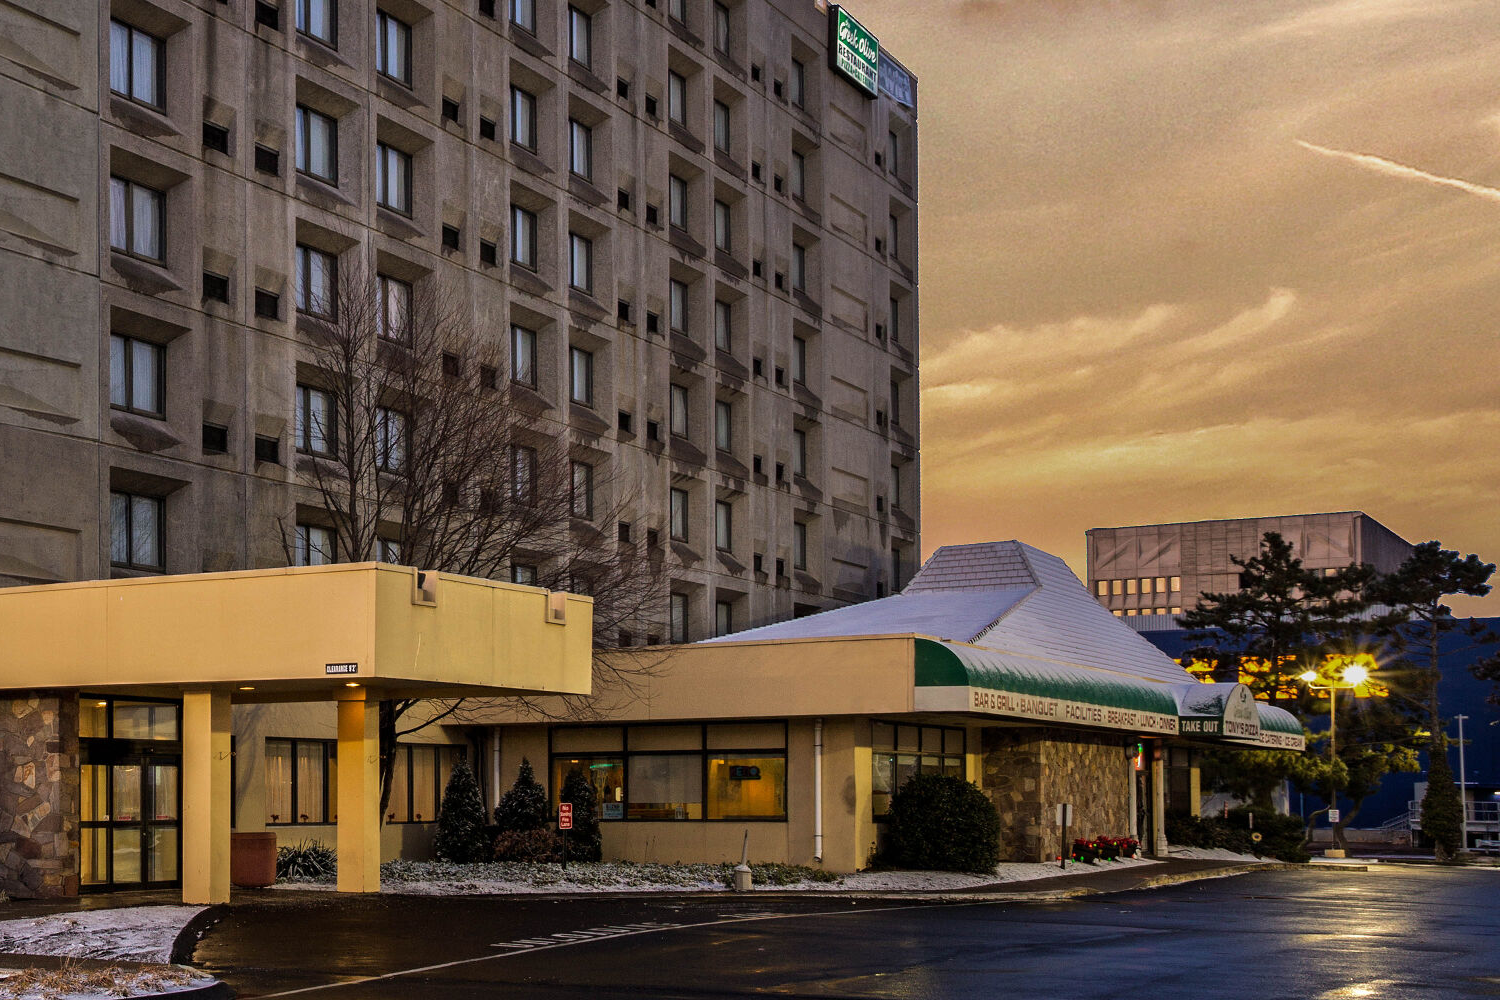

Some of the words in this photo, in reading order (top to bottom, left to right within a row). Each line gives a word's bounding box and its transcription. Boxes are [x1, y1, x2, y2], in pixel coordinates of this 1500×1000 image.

[839, 43, 877, 82] RESTAURANT
[859, 37, 876, 63] Olive
[974, 691, 989, 709] BAR
[996, 694, 1015, 712] GRILL
[1065, 704, 1102, 722] FACILITIES
[1107, 710, 1137, 726] BREAKFAST
[1140, 714, 1157, 728] LUNCH
[1159, 717, 1176, 731] DINNER
[1181, 720, 1201, 733] TAKE
[1203, 720, 1219, 733] OUT
[1225, 720, 1245, 736] TONY'S
[1244, 723, 1259, 737] PIZZA
